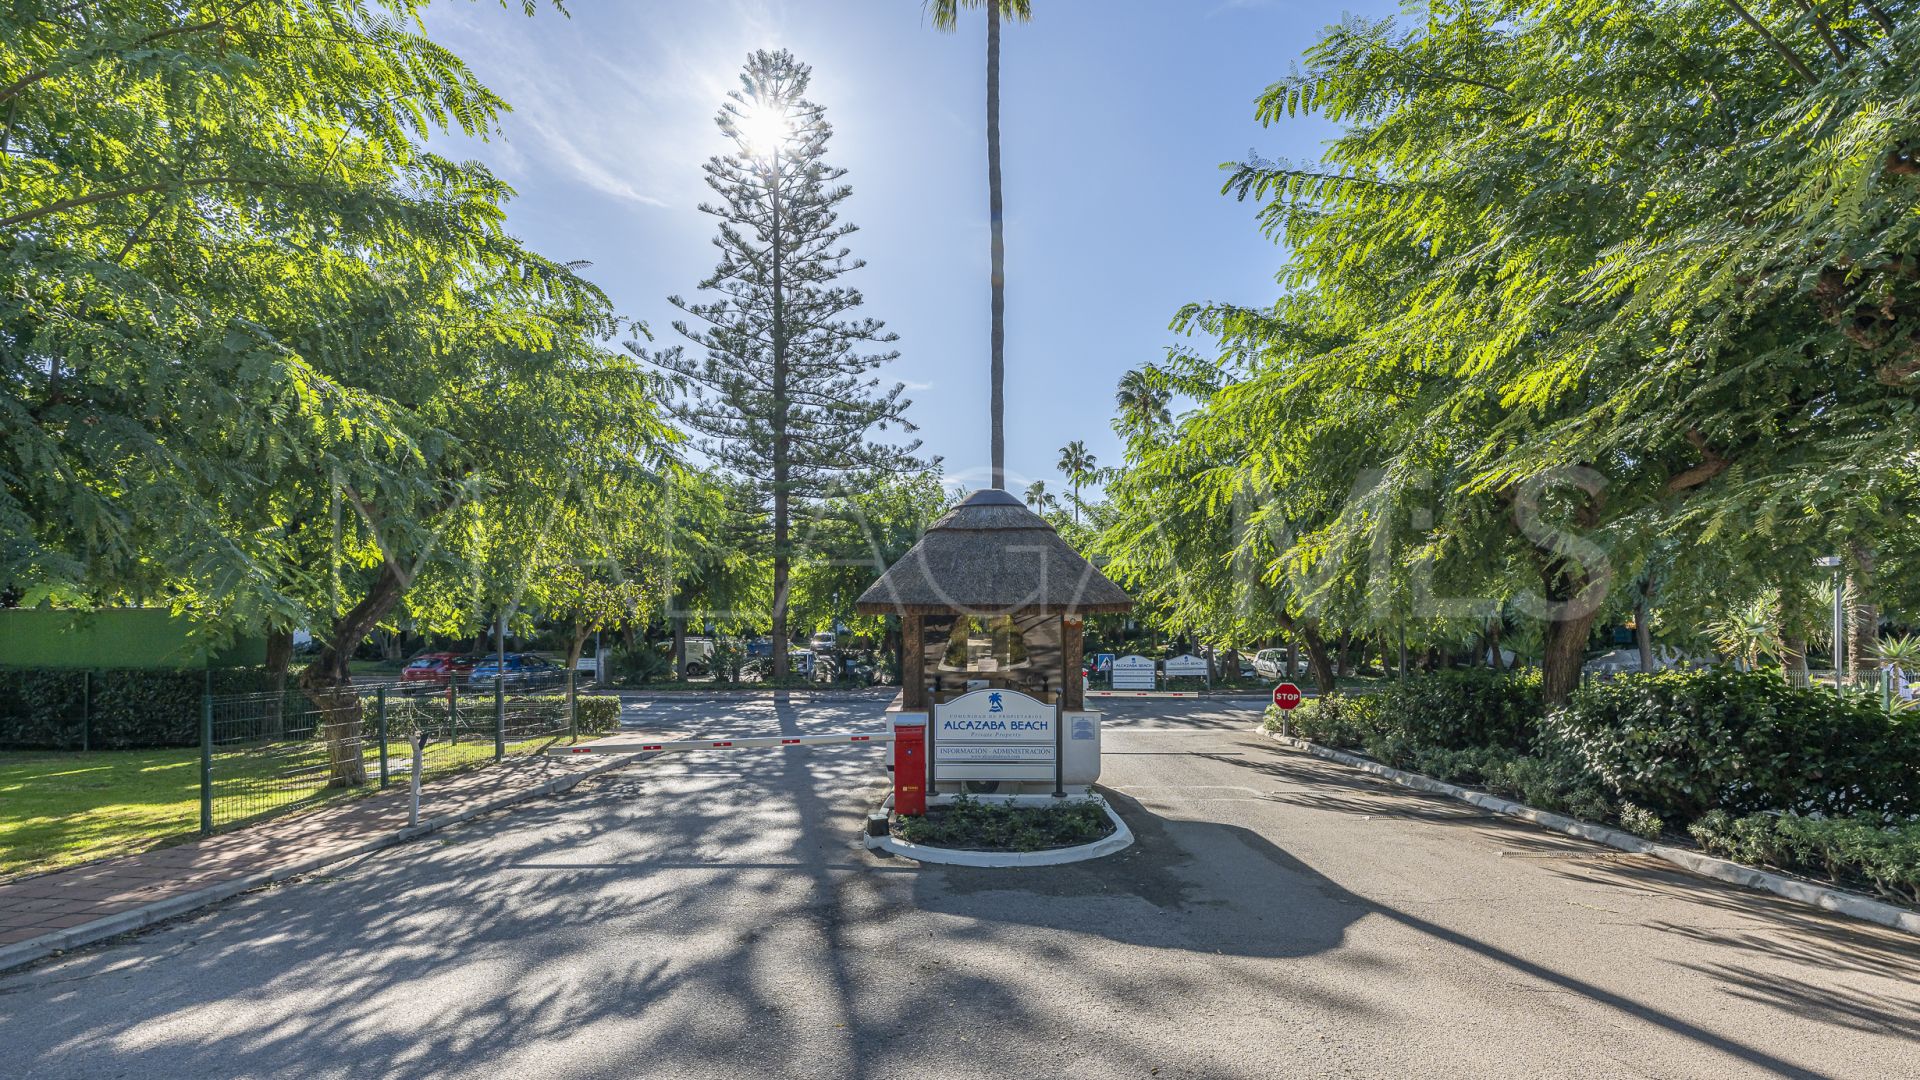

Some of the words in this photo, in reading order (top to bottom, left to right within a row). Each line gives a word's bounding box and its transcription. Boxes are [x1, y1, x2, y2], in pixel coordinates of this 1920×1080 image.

[1276, 693, 1299, 701] STOP
[943, 720, 1007, 731] ALCAZABA
[1010, 720, 1049, 731] BEACH
